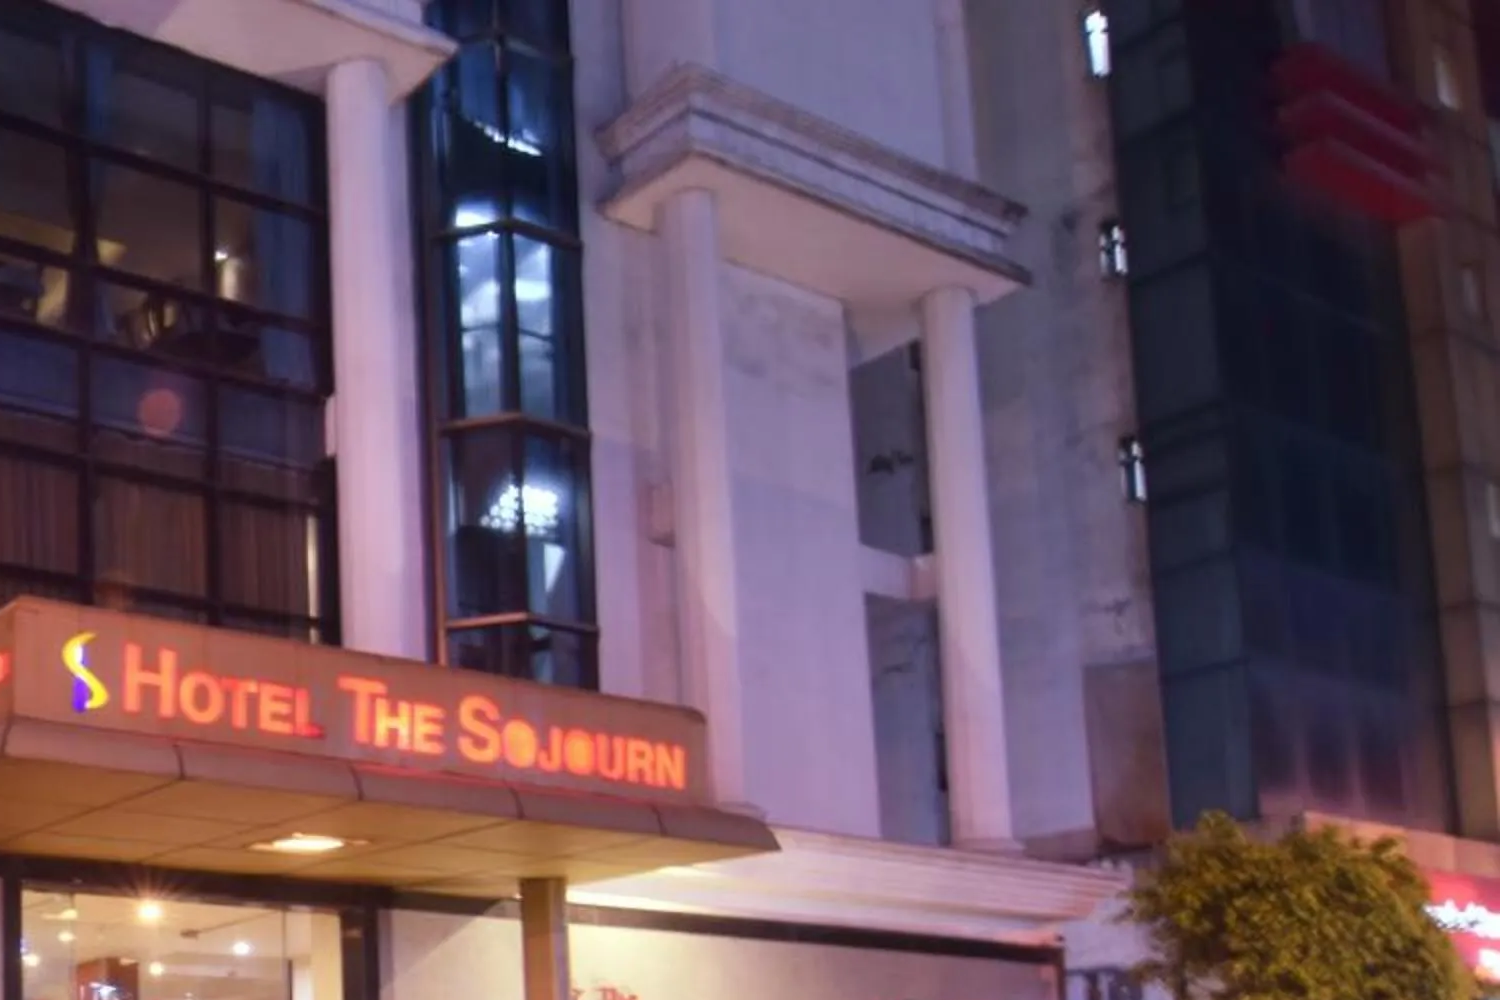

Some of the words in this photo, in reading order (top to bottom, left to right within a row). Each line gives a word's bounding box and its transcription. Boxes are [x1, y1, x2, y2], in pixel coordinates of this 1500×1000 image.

[123, 641, 323, 738] HOTEL
[337, 677, 445, 755] THE
[457, 694, 686, 790] SOJOURN
